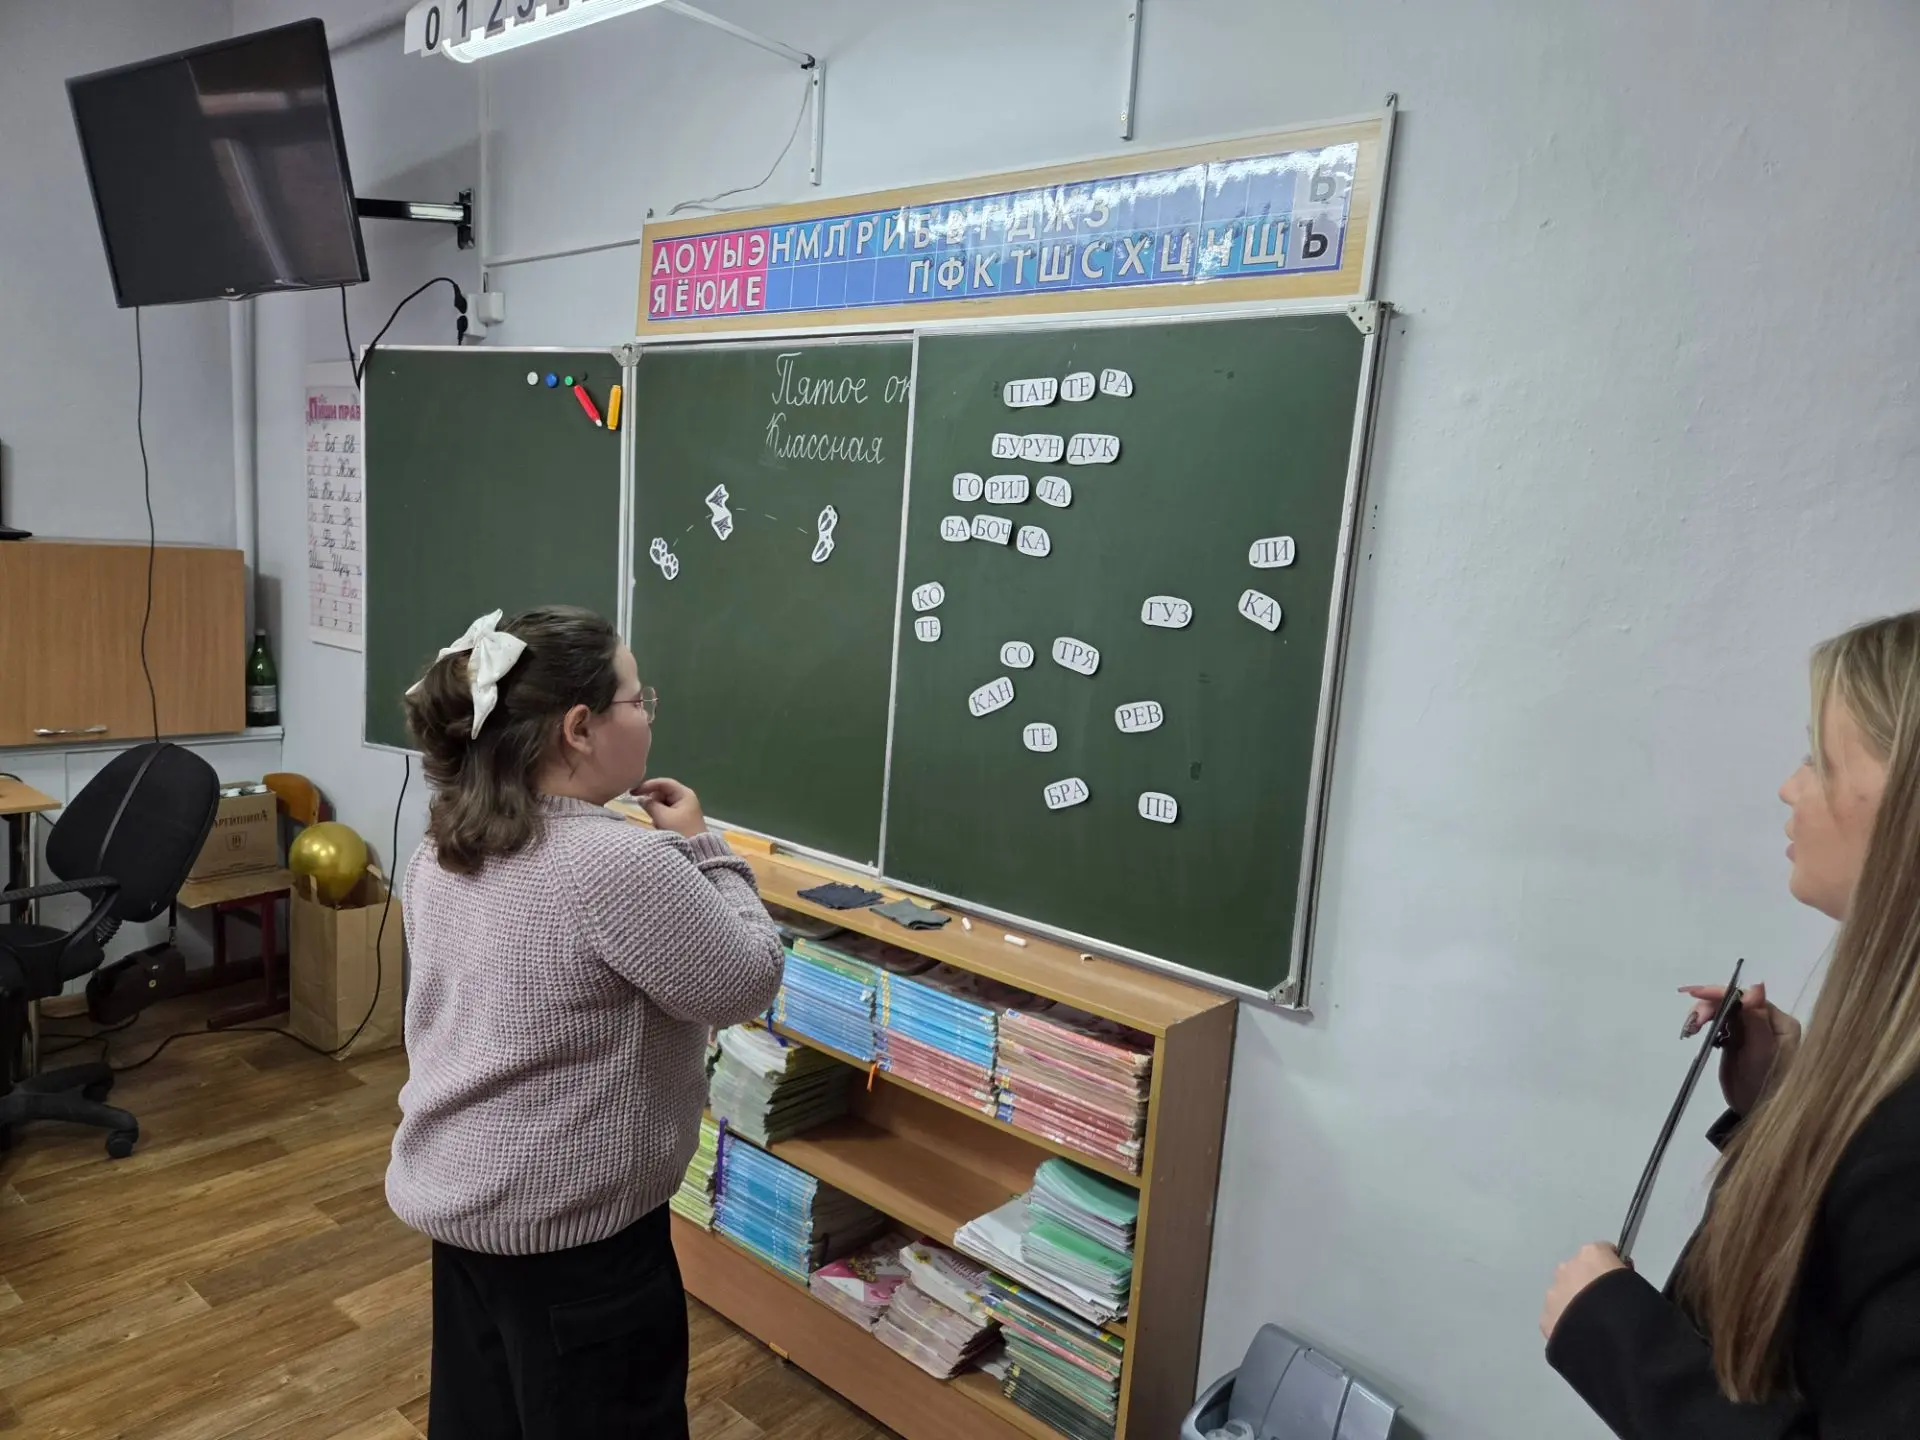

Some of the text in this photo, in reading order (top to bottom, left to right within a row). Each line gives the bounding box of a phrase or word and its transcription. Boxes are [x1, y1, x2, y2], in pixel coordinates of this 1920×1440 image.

[771, 352, 869, 406] Пятое
[1009, 370, 1129, 403] ПАН ТЕ РА
[766, 412, 885, 464] Классная
[1069, 437, 1117, 461] ДУК
[956, 477, 1068, 504] ГО РИЛ ЛА
[945, 518, 1047, 551] БА БОЧ КА
[1253, 539, 1290, 564] ЛИ
[916, 586, 942, 609] КО
[1243, 592, 1275, 625] КА
[1146, 601, 1190, 623] ГУЗ
[916, 619, 939, 638] ТЕ
[1004, 645, 1031, 665] СО
[1059, 640, 1097, 670] ТРЯ
[971, 681, 1013, 713] КАН
[1118, 703, 1162, 729] РЕВ
[1026, 727, 1053, 746] ТЕ
[1046, 779, 1086, 806] БРА
[1144, 795, 1175, 820] ПЕ
